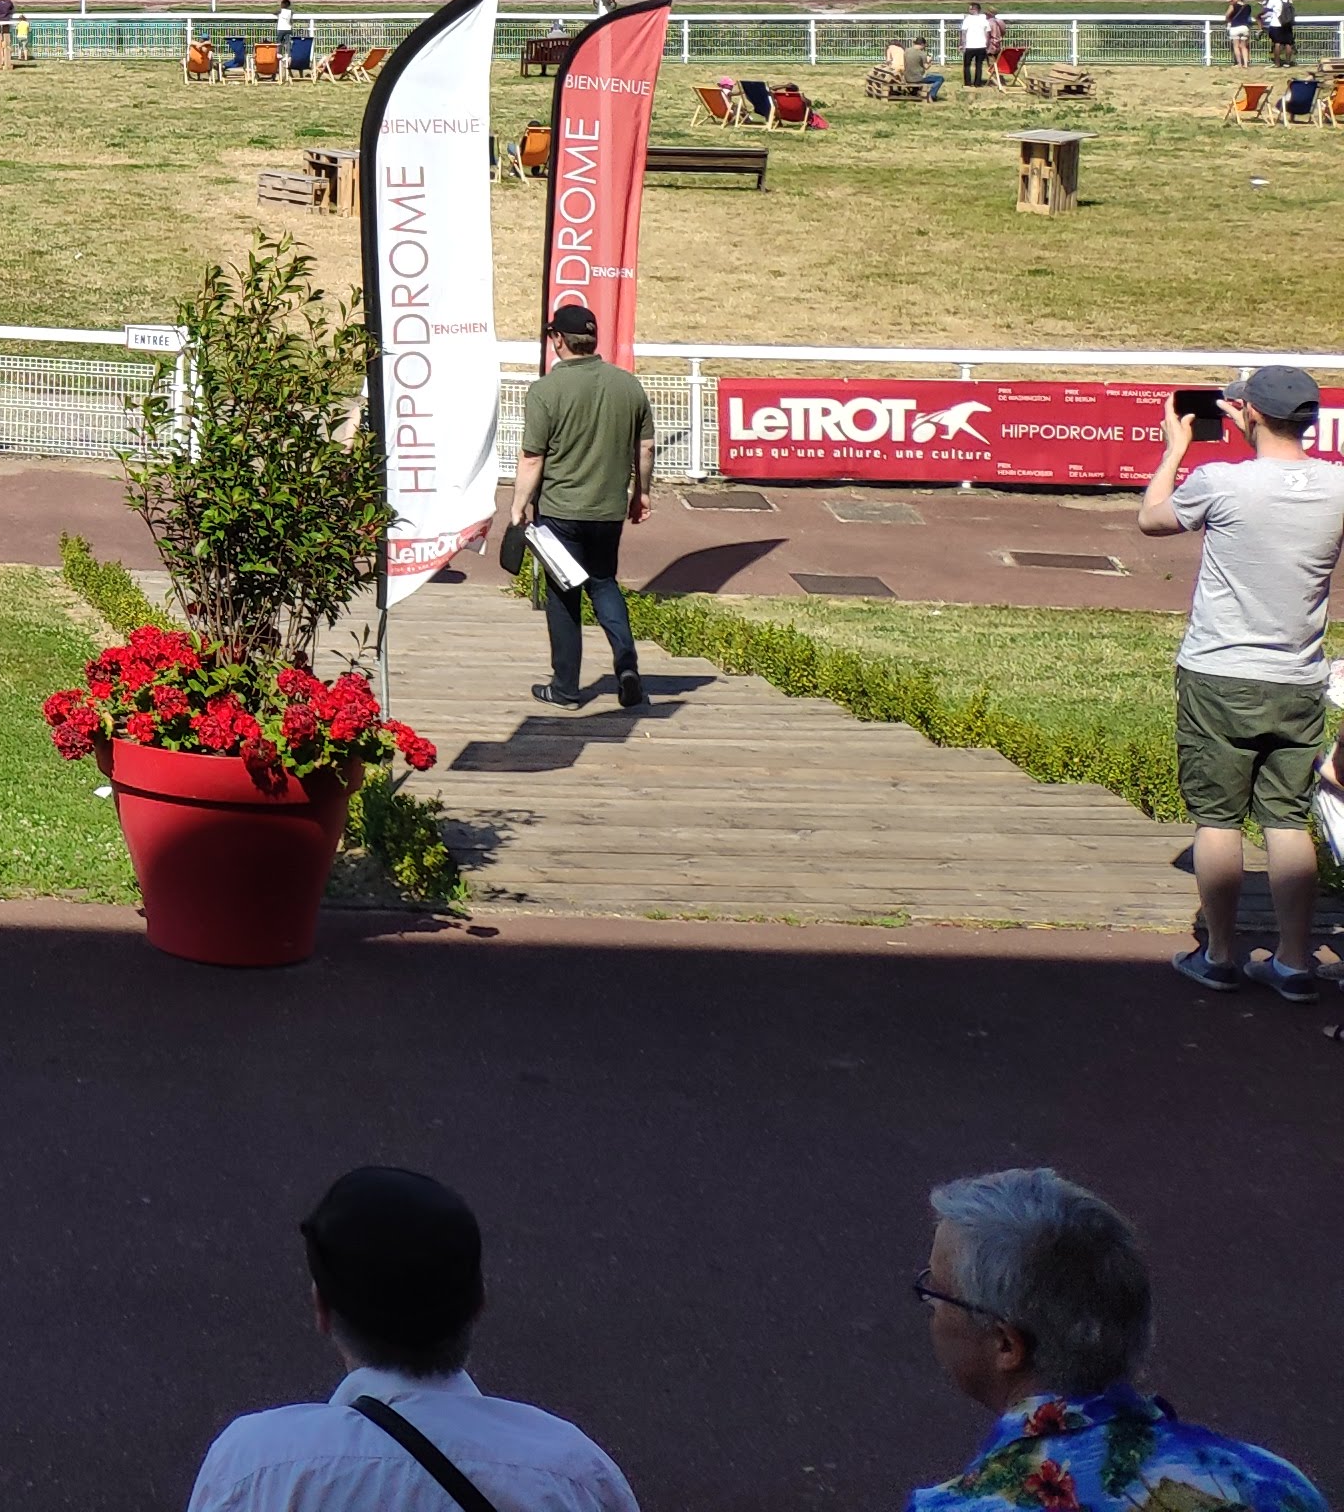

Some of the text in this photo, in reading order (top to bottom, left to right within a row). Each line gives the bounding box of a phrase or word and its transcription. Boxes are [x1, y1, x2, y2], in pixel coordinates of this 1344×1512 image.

[564, 73, 651, 96] BIENVENUE
[379, 118, 481, 134] BIENVENUE
[134, 333, 170, 347] ENTRÉE
[385, 166, 438, 494] HIPPODROME
[728, 398, 907, 442] LeTROT
[1001, 424, 1124, 441] HIPPODROME
[729, 446, 763, 460] plus
[895, 449, 924, 459] une
[931, 448, 992, 460] culture
[390, 535, 458, 564] LeTROT
